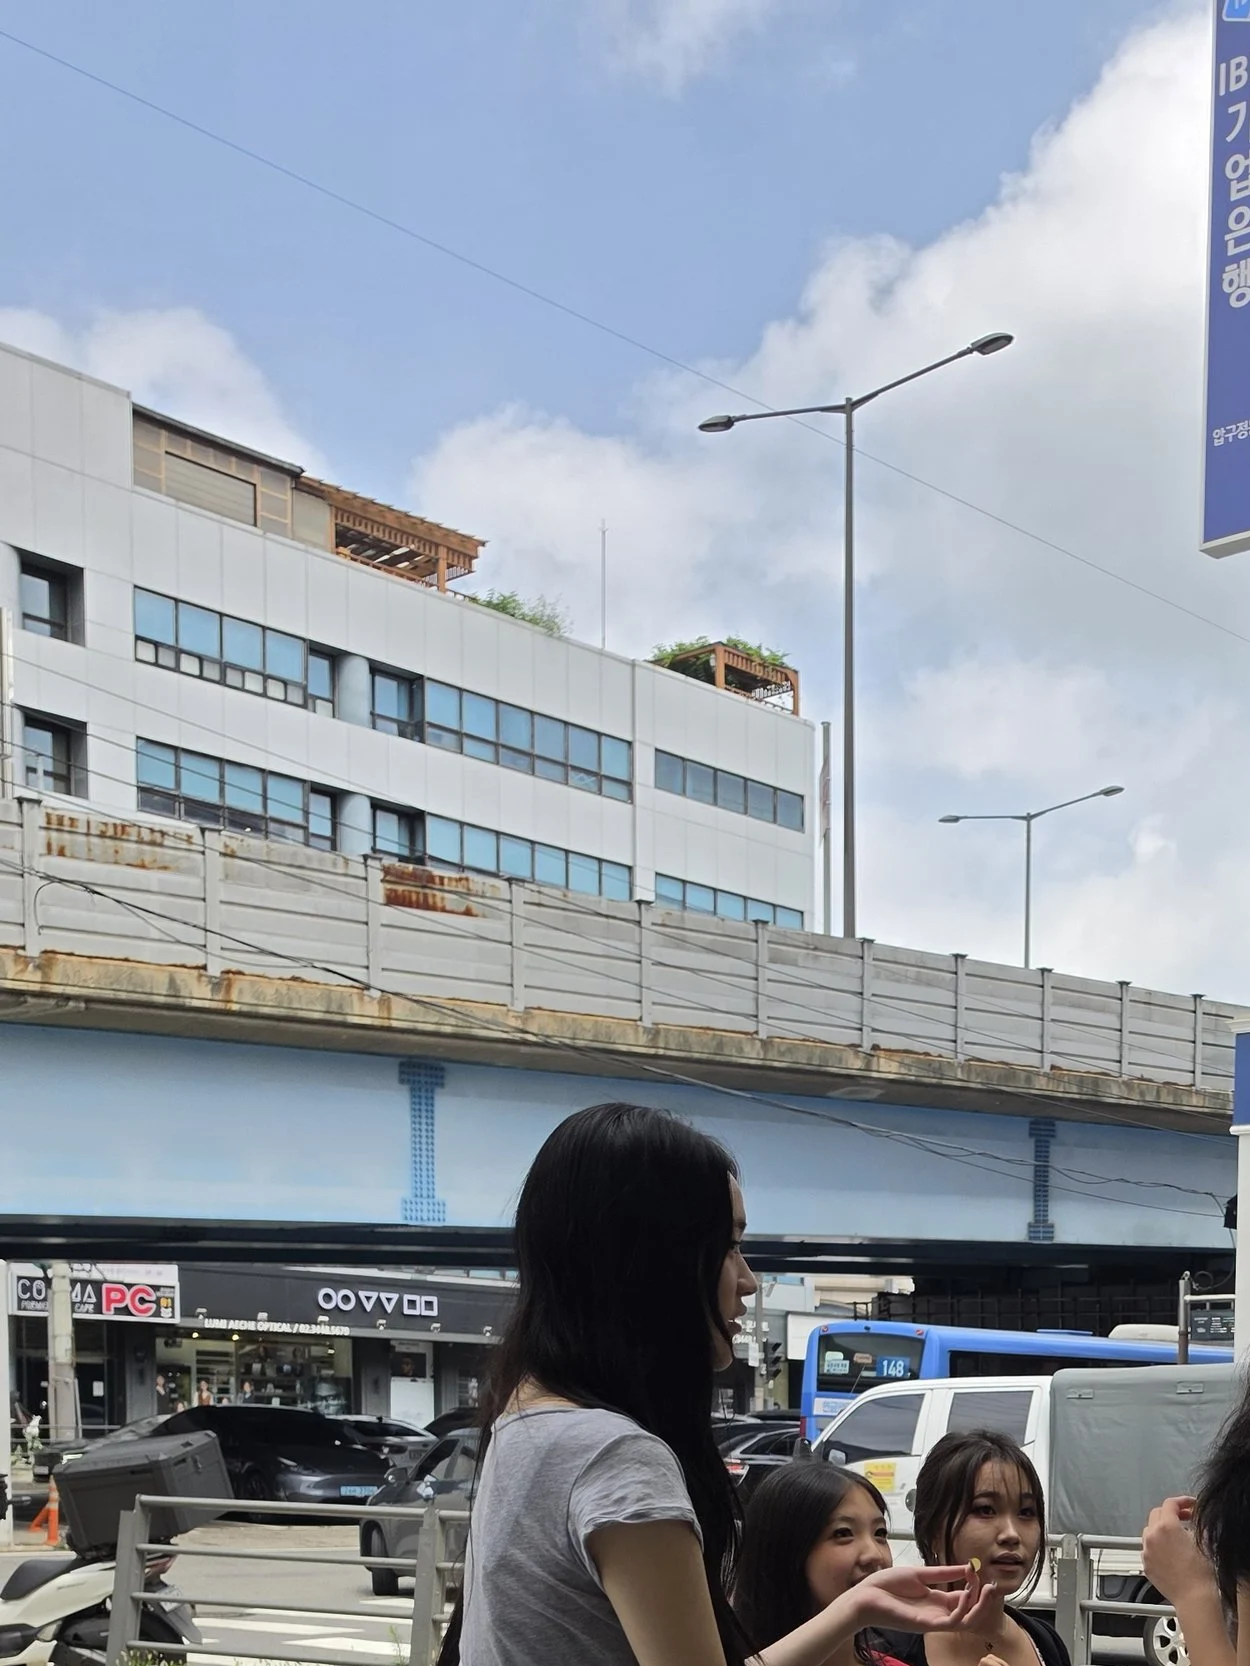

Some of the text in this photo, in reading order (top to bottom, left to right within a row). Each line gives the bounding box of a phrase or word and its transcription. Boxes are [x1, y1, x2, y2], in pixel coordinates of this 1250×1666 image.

[102, 1283, 156, 1317] PC
[257, 1321, 292, 1333] OPTICAL
[882, 1359, 904, 1378] 148
